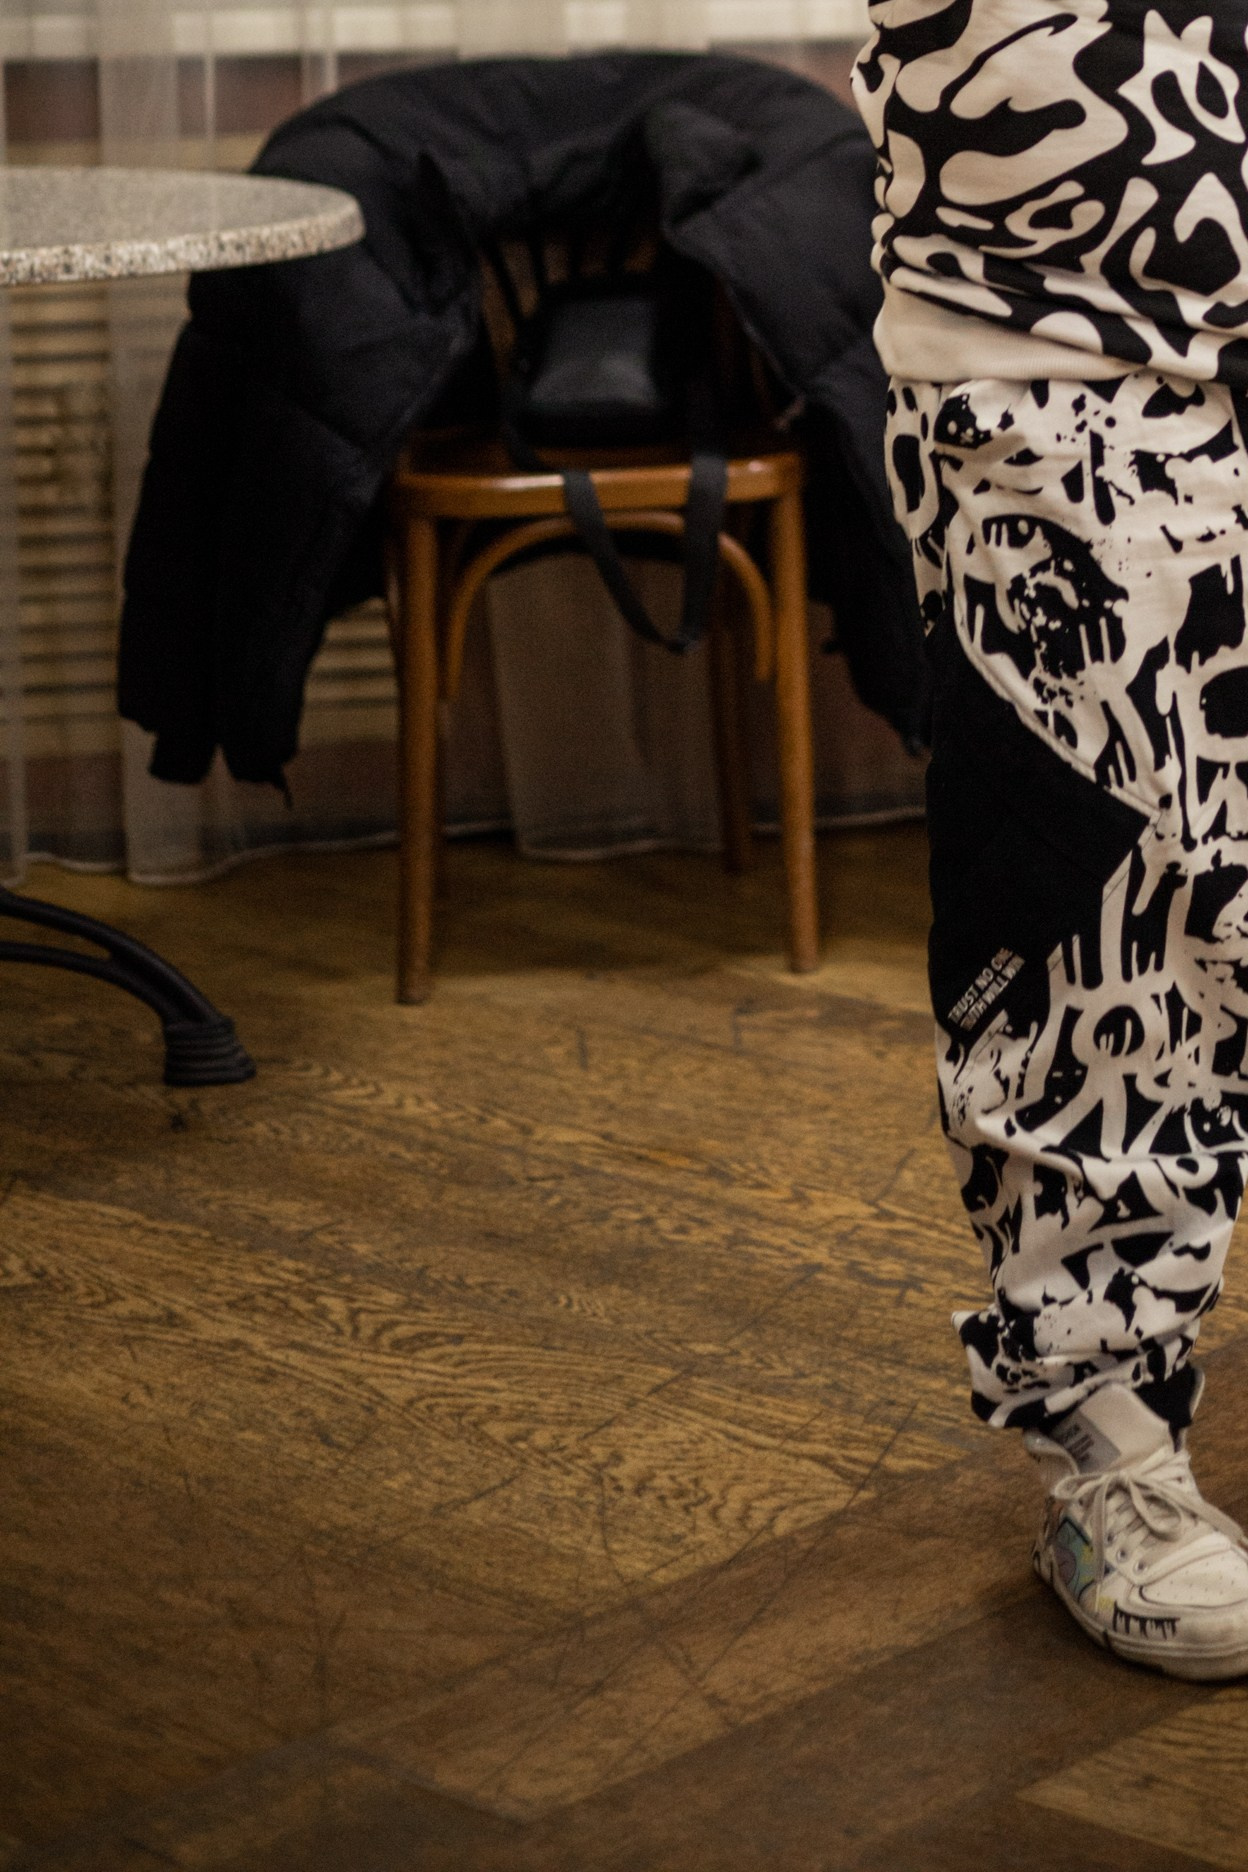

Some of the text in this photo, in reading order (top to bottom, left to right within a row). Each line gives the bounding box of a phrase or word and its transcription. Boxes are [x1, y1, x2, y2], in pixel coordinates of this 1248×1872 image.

[948, 984, 979, 1024] TRUST
[975, 967, 994, 991] NO
[981, 975, 1009, 1005] WILL
